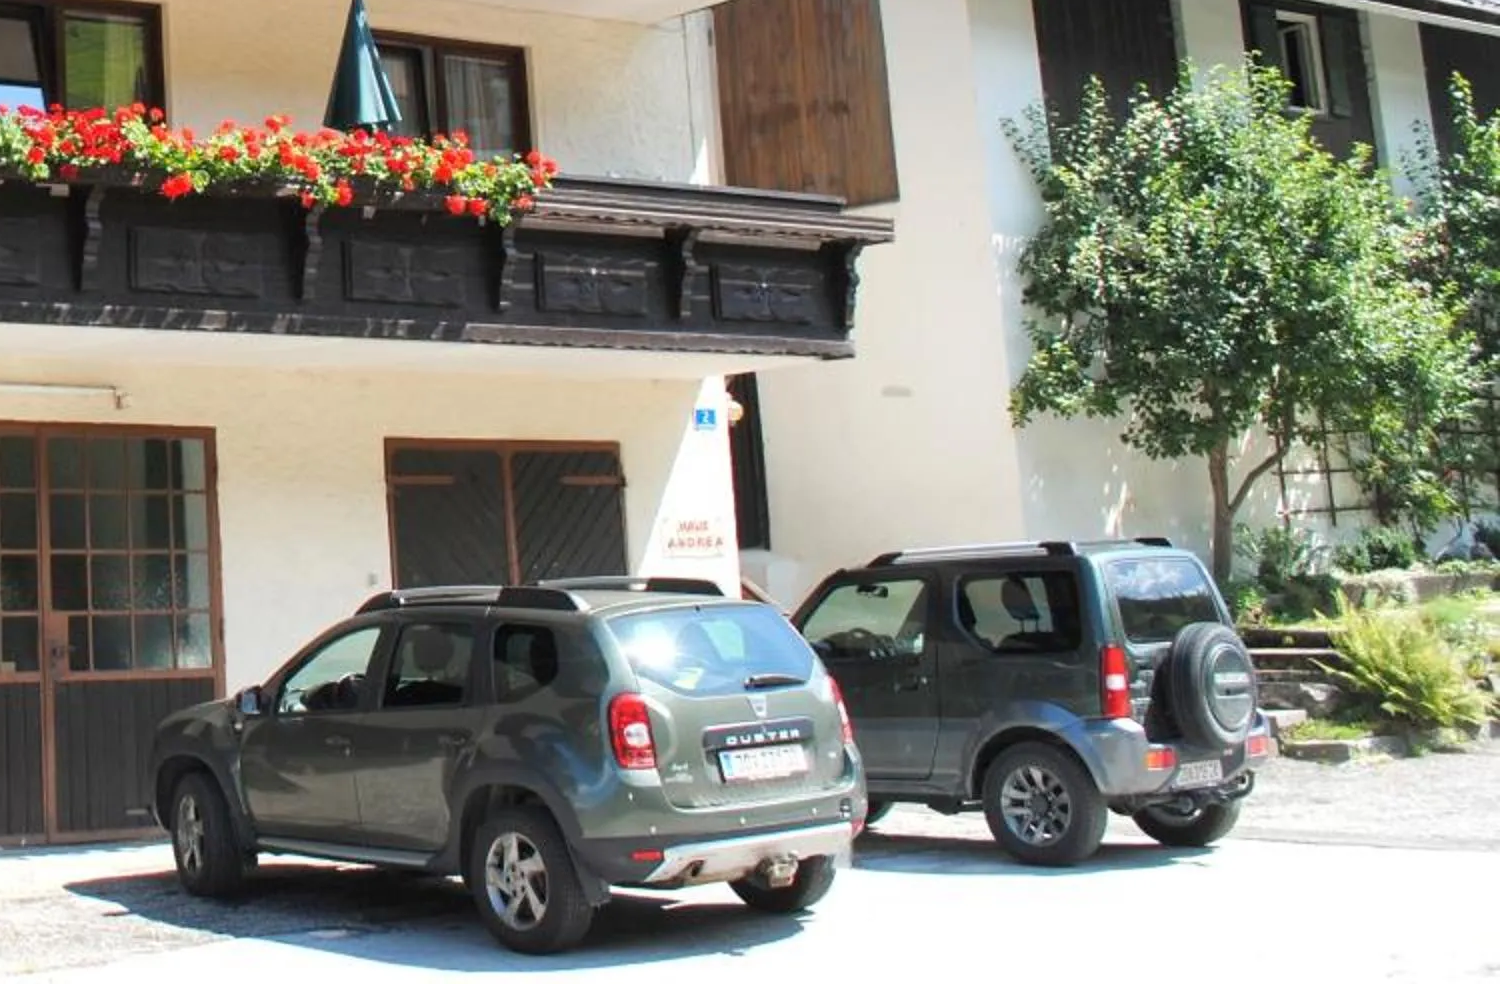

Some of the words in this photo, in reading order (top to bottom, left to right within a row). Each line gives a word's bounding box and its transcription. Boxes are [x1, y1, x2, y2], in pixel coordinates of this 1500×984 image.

[678, 520, 709, 532] HAUS
[667, 536, 724, 549] ANDREA
[725, 729, 800, 745] DUSTER
